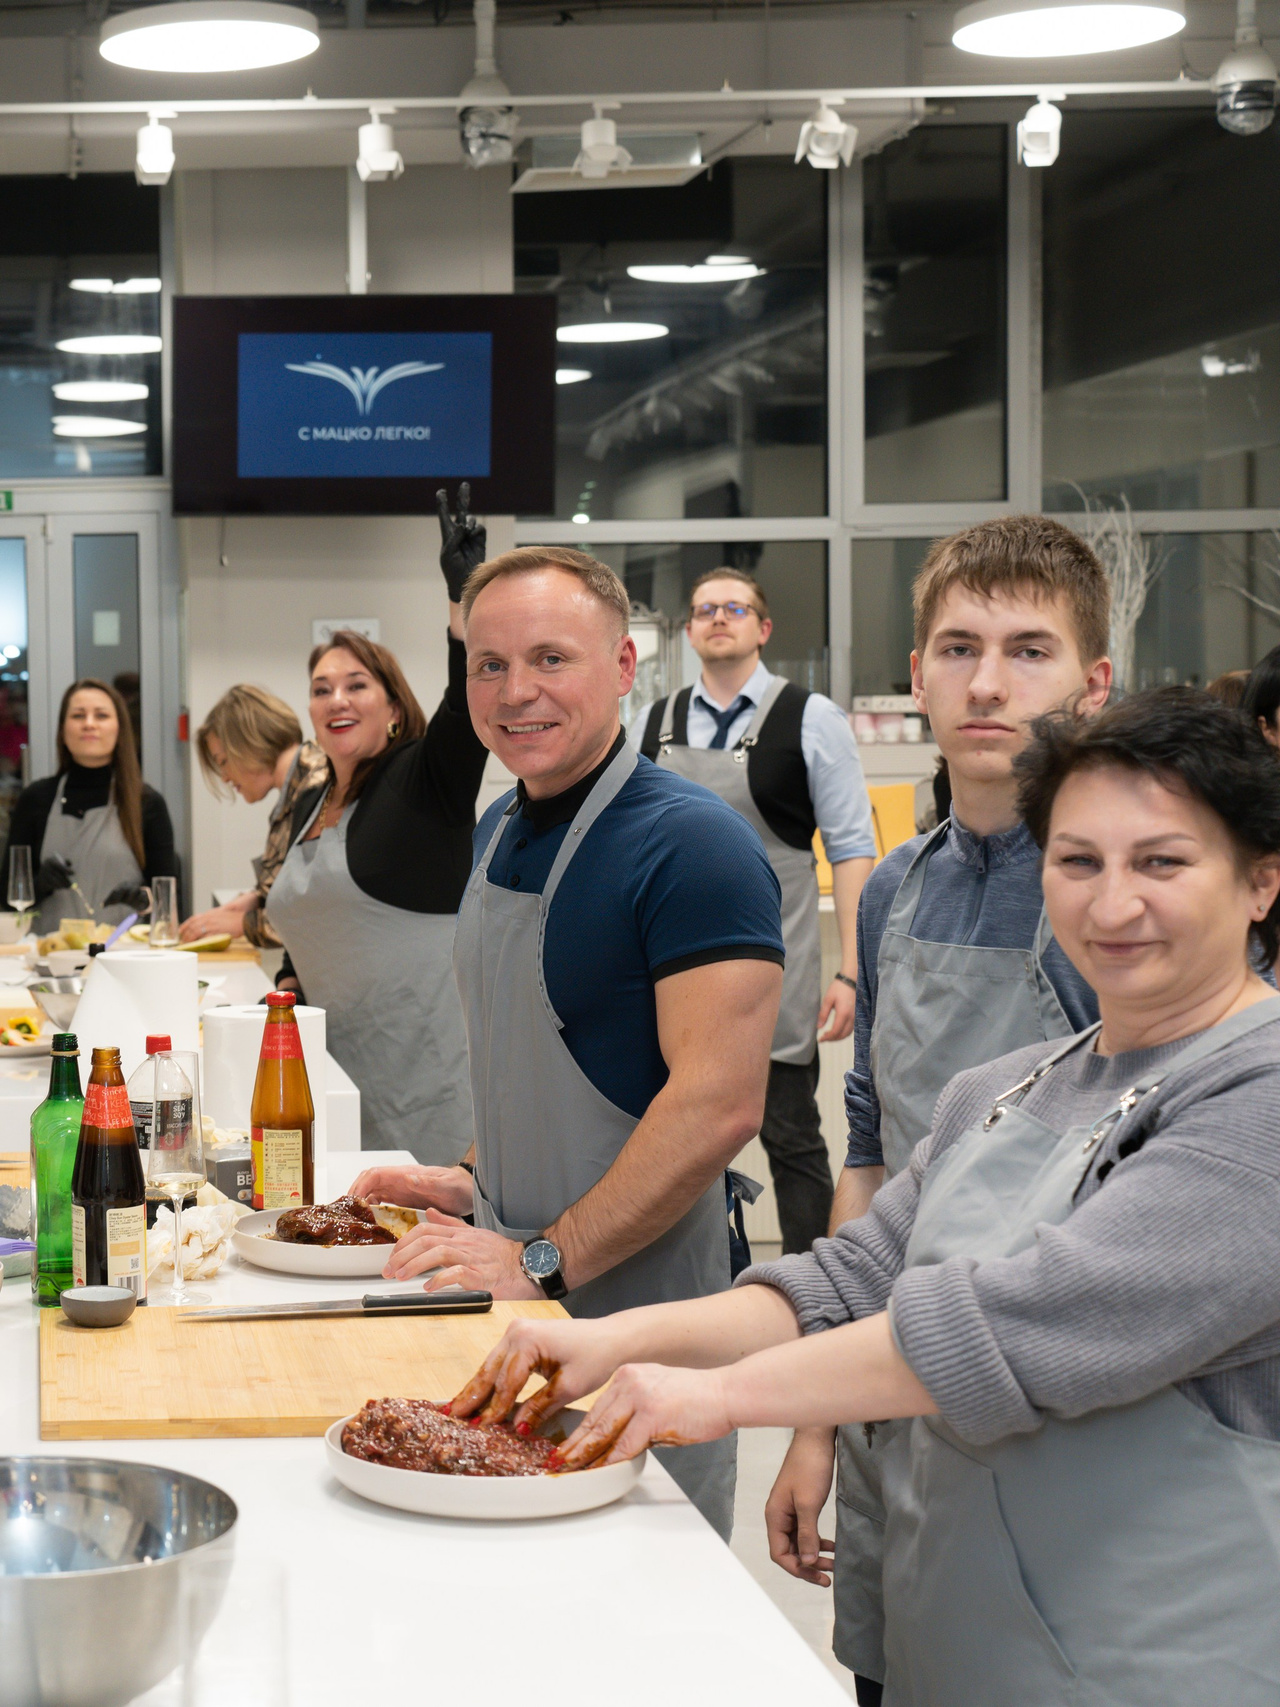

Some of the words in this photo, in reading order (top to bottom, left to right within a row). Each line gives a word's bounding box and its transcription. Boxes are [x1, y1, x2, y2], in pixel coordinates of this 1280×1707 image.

[298, 426, 310, 441] С
[313, 426, 372, 443] МАЦКО
[374, 426, 431, 441] ЛЕГКО!
